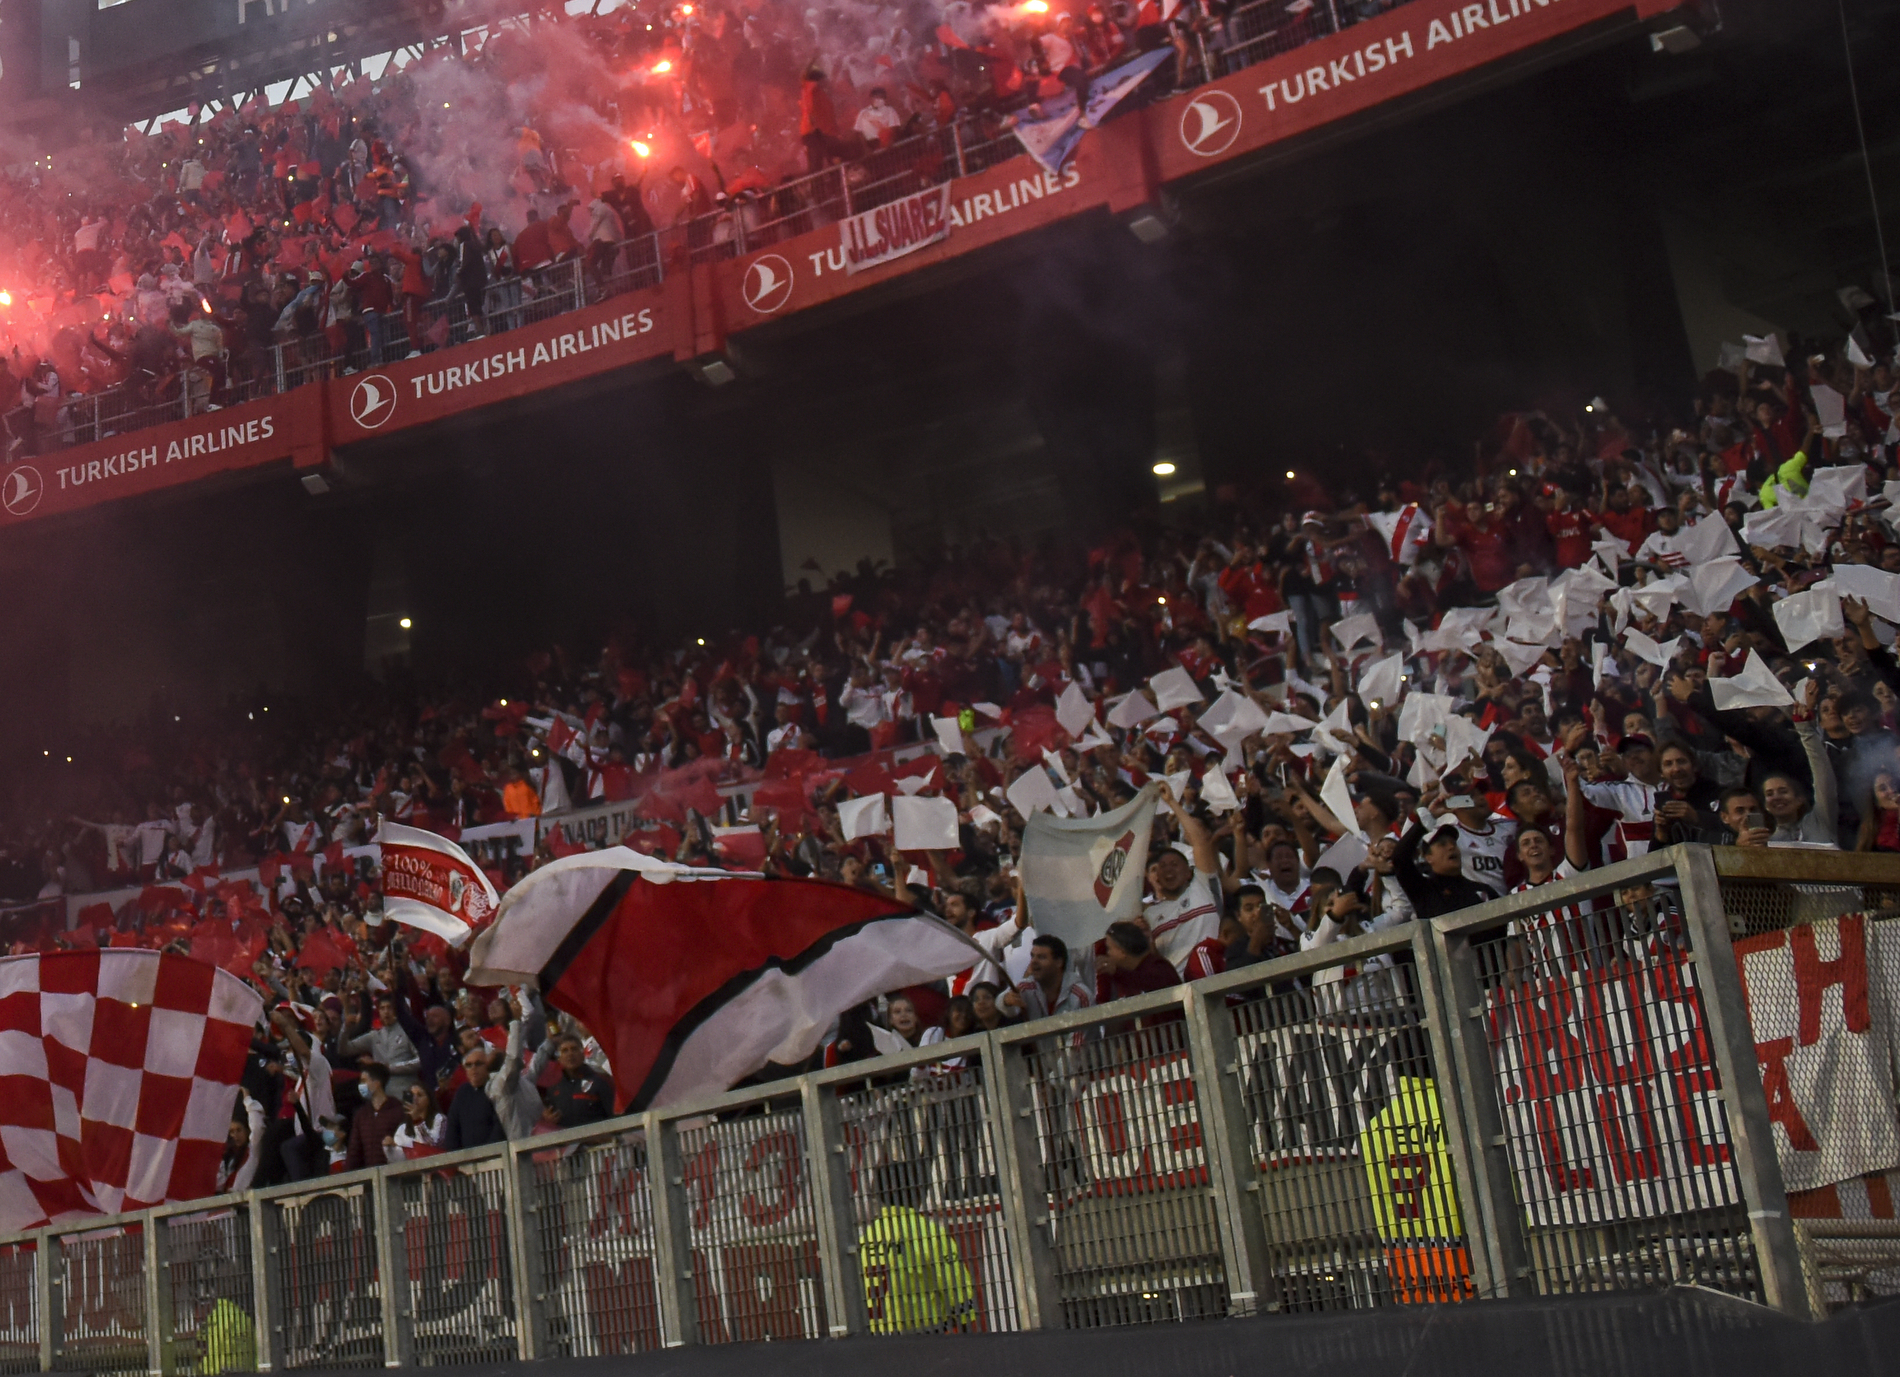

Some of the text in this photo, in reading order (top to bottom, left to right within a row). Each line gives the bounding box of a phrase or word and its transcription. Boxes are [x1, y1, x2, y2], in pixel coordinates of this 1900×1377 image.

[1259, 31, 1414, 111] TURKISH
[410, 308, 654, 399] TURKISH AIRLINES
[56, 415, 275, 490] TURKISH AIRLINES
[393, 853, 433, 880] 100%
[1473, 855, 1503, 872] BBV
